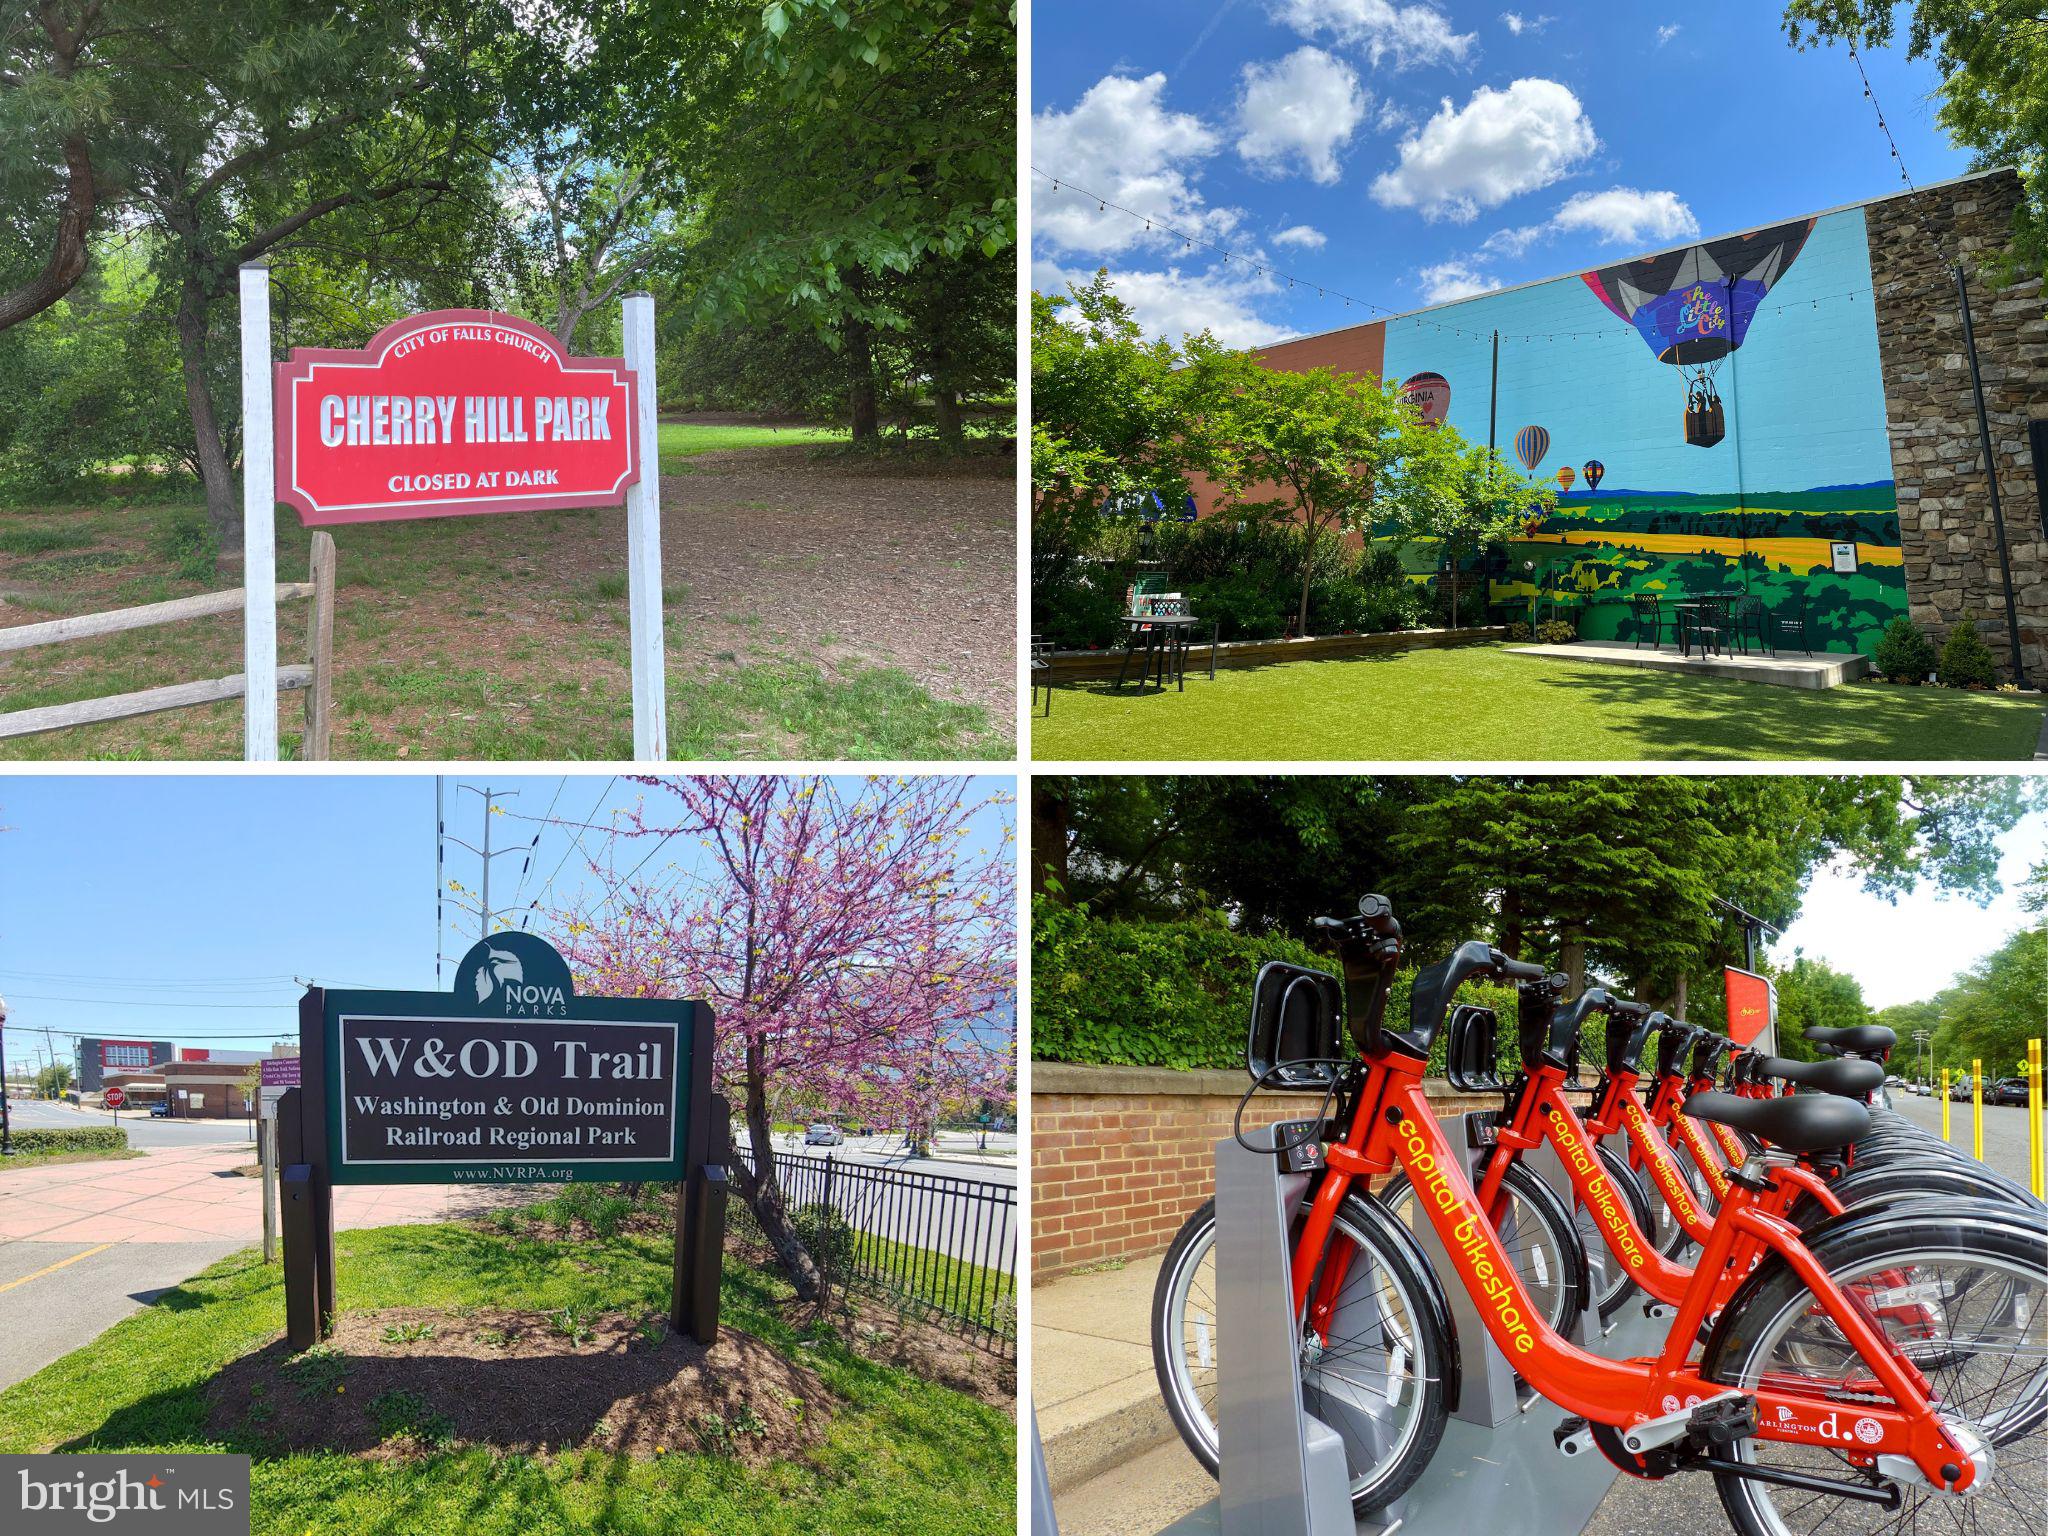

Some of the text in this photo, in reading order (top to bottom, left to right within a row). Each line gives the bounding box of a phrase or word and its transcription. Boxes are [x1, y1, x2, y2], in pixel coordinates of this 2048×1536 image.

[1682, 286, 1713, 304] The
[1677, 300, 1723, 334] Little
[1698, 314, 1725, 334] City
[394, 328, 551, 364] CITY OF FALLS CHURCH
[1399, 391, 1434, 405] IRGINIA
[320, 394, 611, 447] CHERRY HILL PARK
[388, 469, 559, 493] CLOSED AT DARK
[506, 985, 565, 1004] NOVA
[506, 1004, 567, 1016] PARKS
[355, 1037, 664, 1081] W&OD Trail
[107, 1093, 122, 1101] STOP
[354, 1096, 665, 1120] Washington & Old Dominion
[386, 1126, 637, 1150] Railroad Regional Park
[1723, 1136, 1745, 1168] bikesh
[453, 1167, 573, 1180] www.NVRPA.org
[1626, 1104, 1697, 1225] capital bikeshare
[1696, 1141, 1731, 1198] bikeshare
[1549, 1110, 1644, 1268] capital bikeshare
[1399, 1119, 1534, 1353] capital bikeshare
[1759, 1420, 1817, 1433] ARLINGTON
